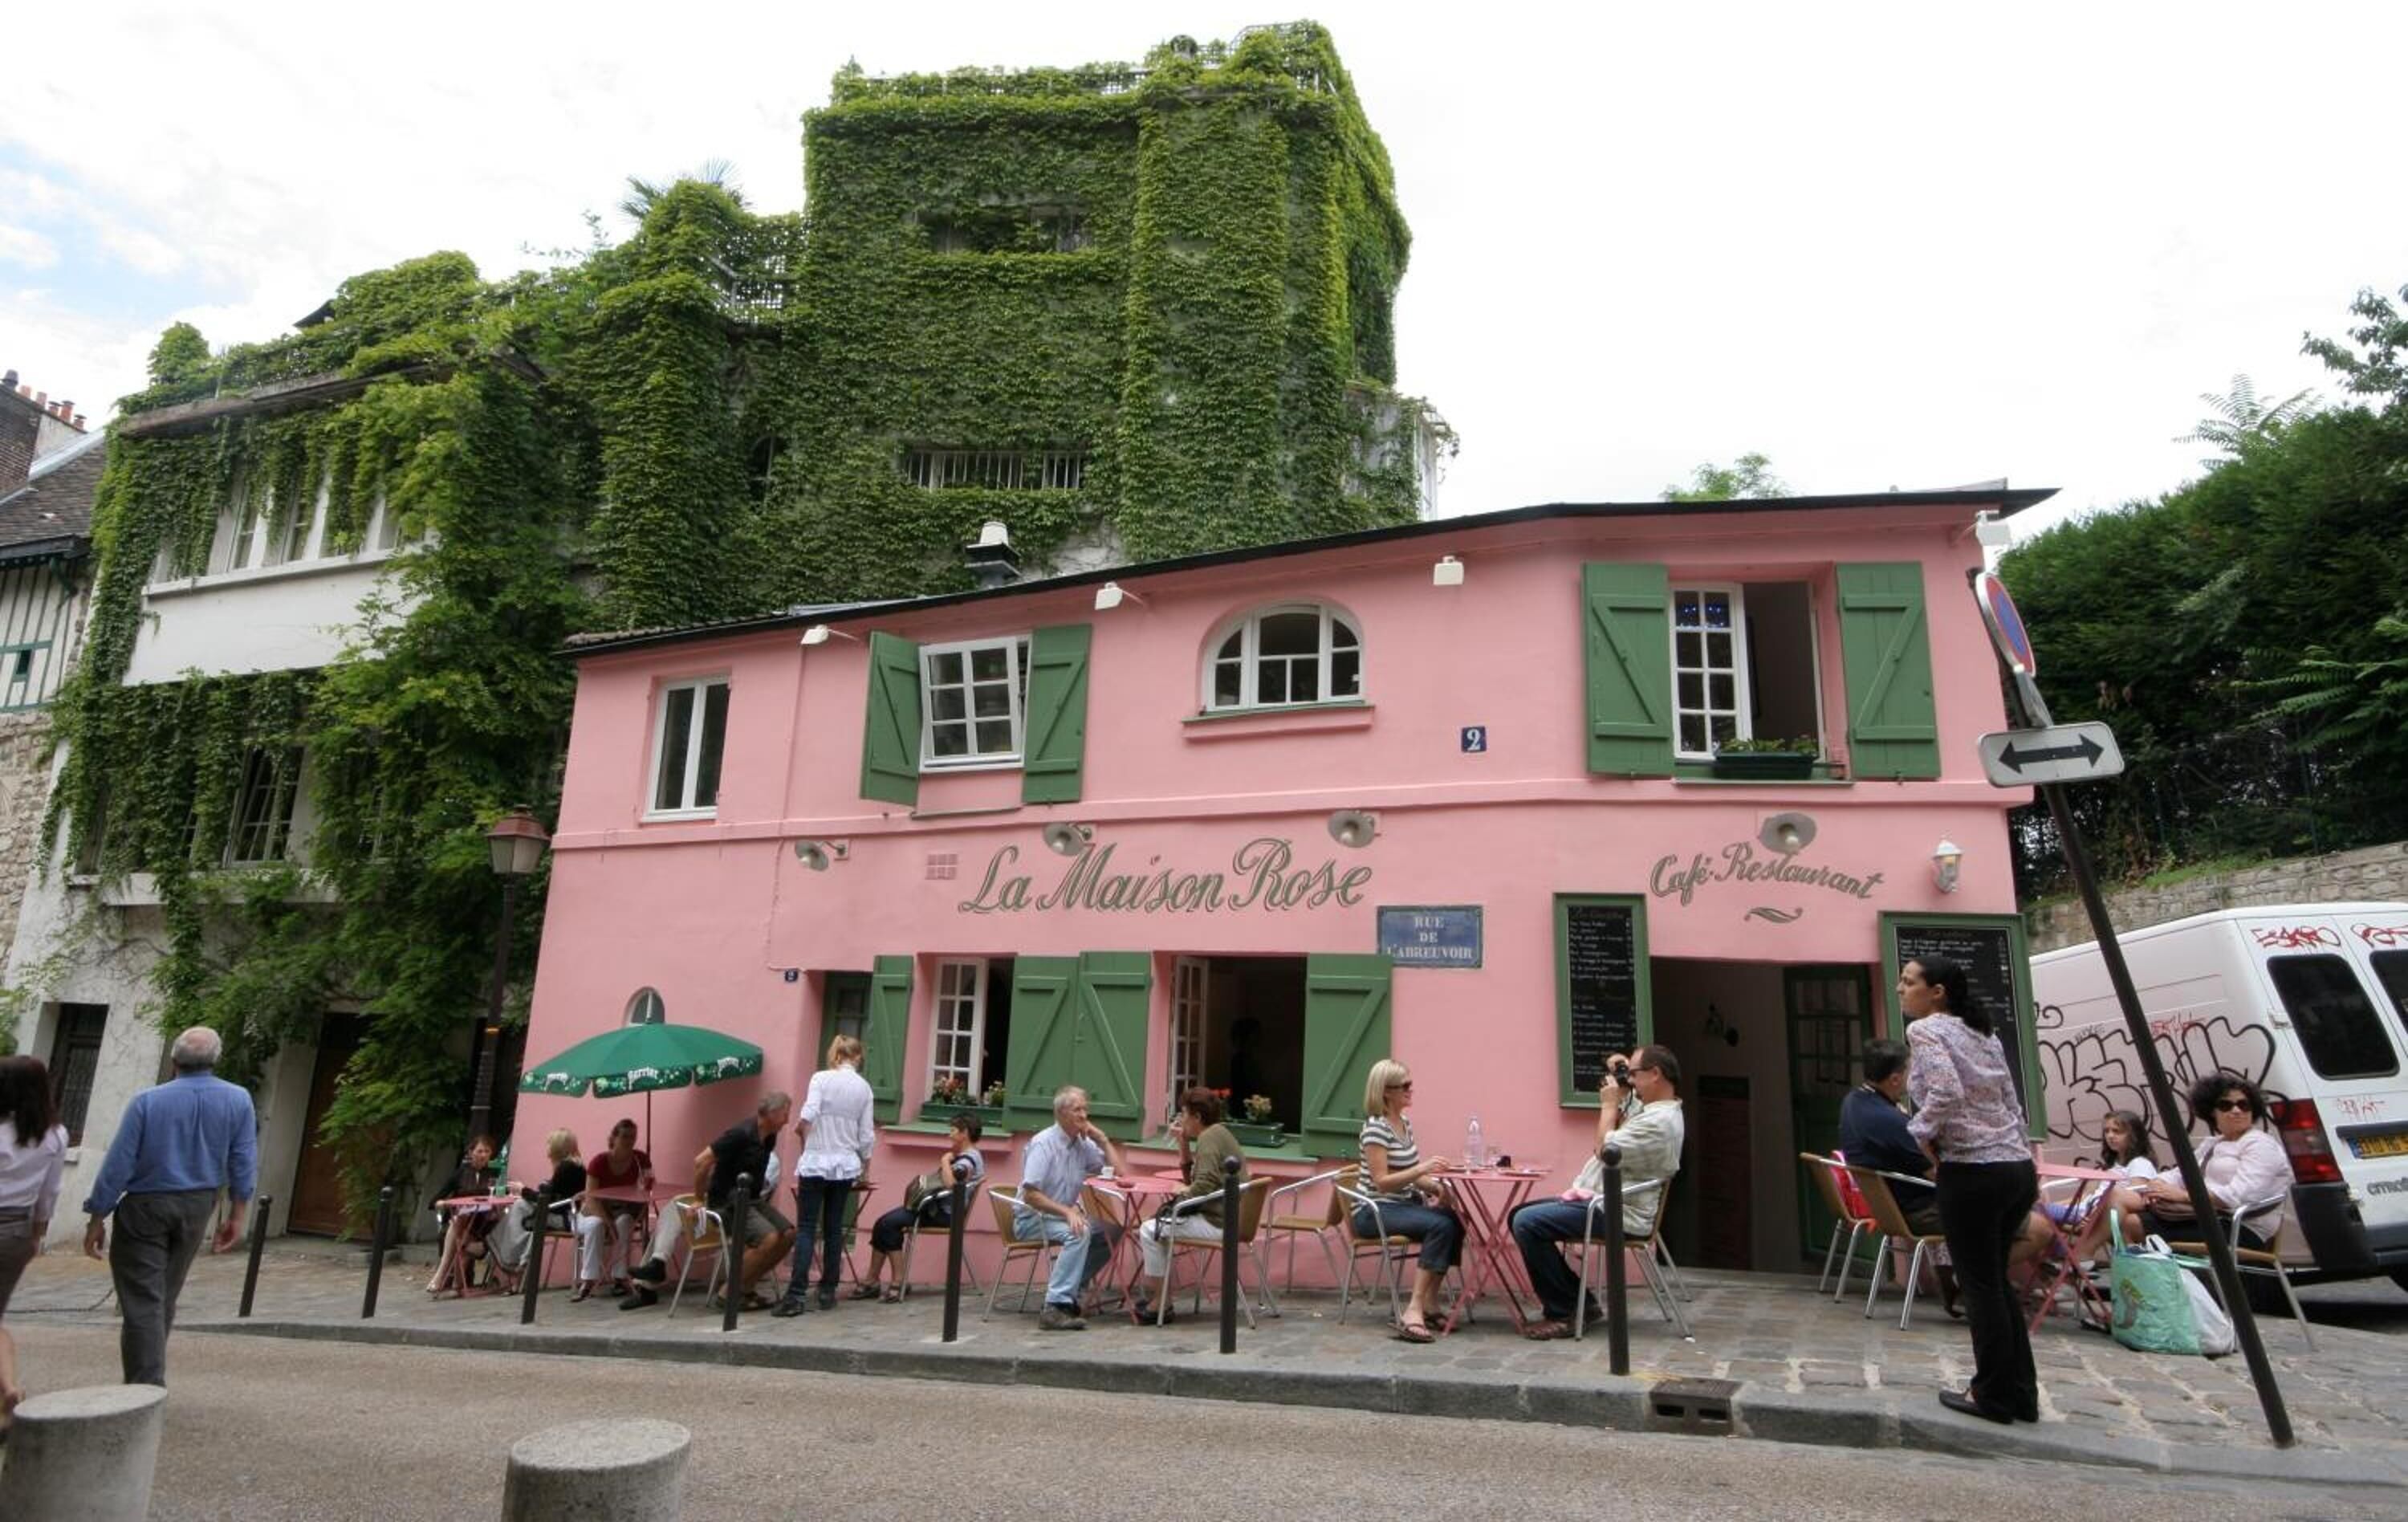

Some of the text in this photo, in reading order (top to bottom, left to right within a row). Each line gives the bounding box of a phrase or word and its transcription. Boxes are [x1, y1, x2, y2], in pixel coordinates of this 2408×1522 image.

[1466, 728, 1481, 751] 2
[958, 837, 1373, 914] La Maison Rose
[1714, 841, 1885, 899] Restaurant
[1413, 916, 1445, 929] RUE
[1419, 932, 1438, 943] DE
[1387, 945, 1473, 959] L'ABREUVOIR
